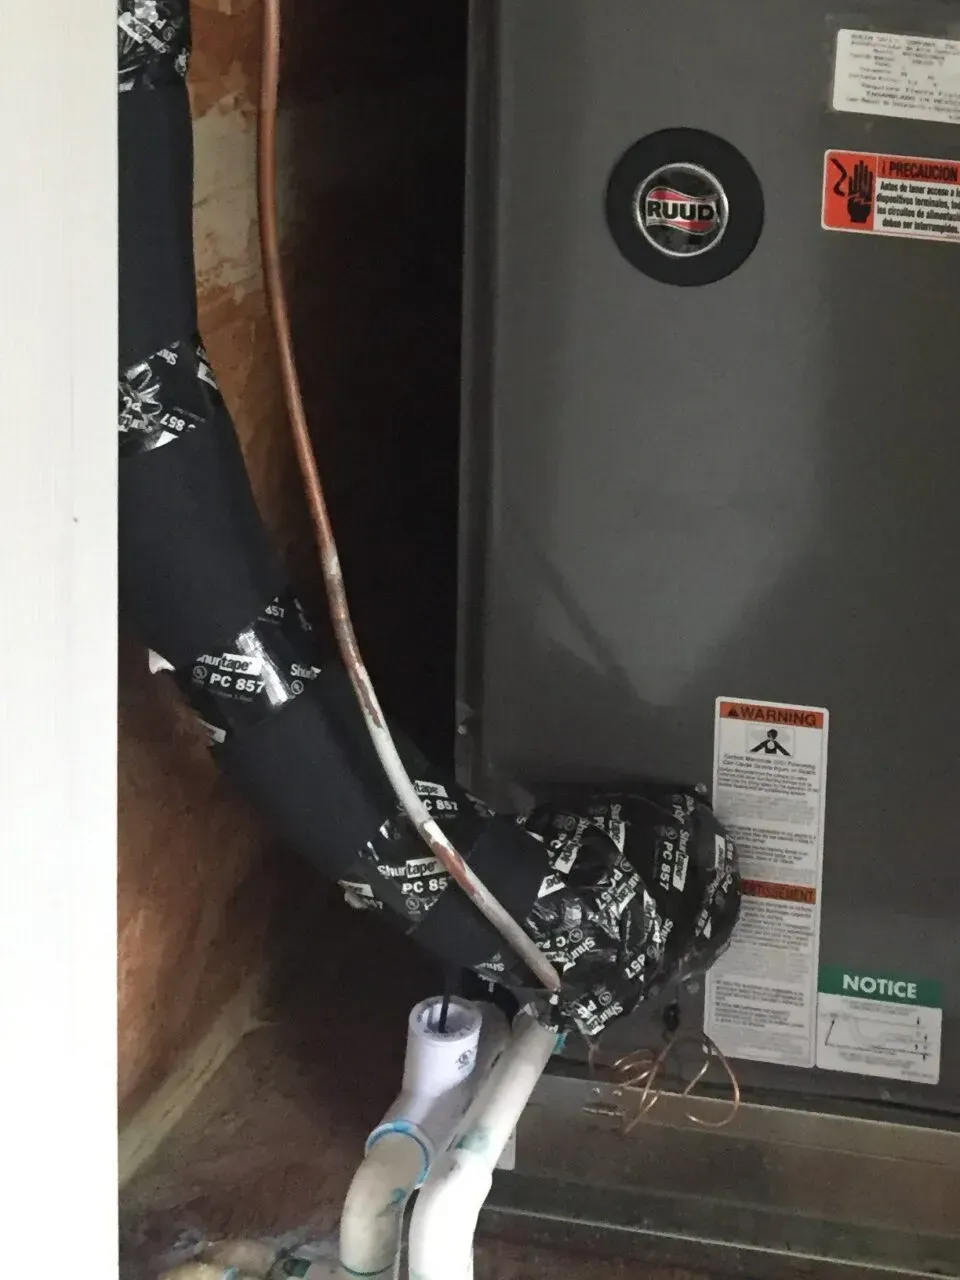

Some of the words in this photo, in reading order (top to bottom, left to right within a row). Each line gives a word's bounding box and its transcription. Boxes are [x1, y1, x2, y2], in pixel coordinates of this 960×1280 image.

[647, 201, 715, 221] RUUD
[209, 672, 231, 688] PC
[235, 678, 265, 694] 857
[741, 707, 816, 726] WARNING
[662, 841, 674, 860] PC
[660, 863, 671, 891] 857
[402, 881, 423, 894] PC
[842, 974, 917, 999] NOTICE
